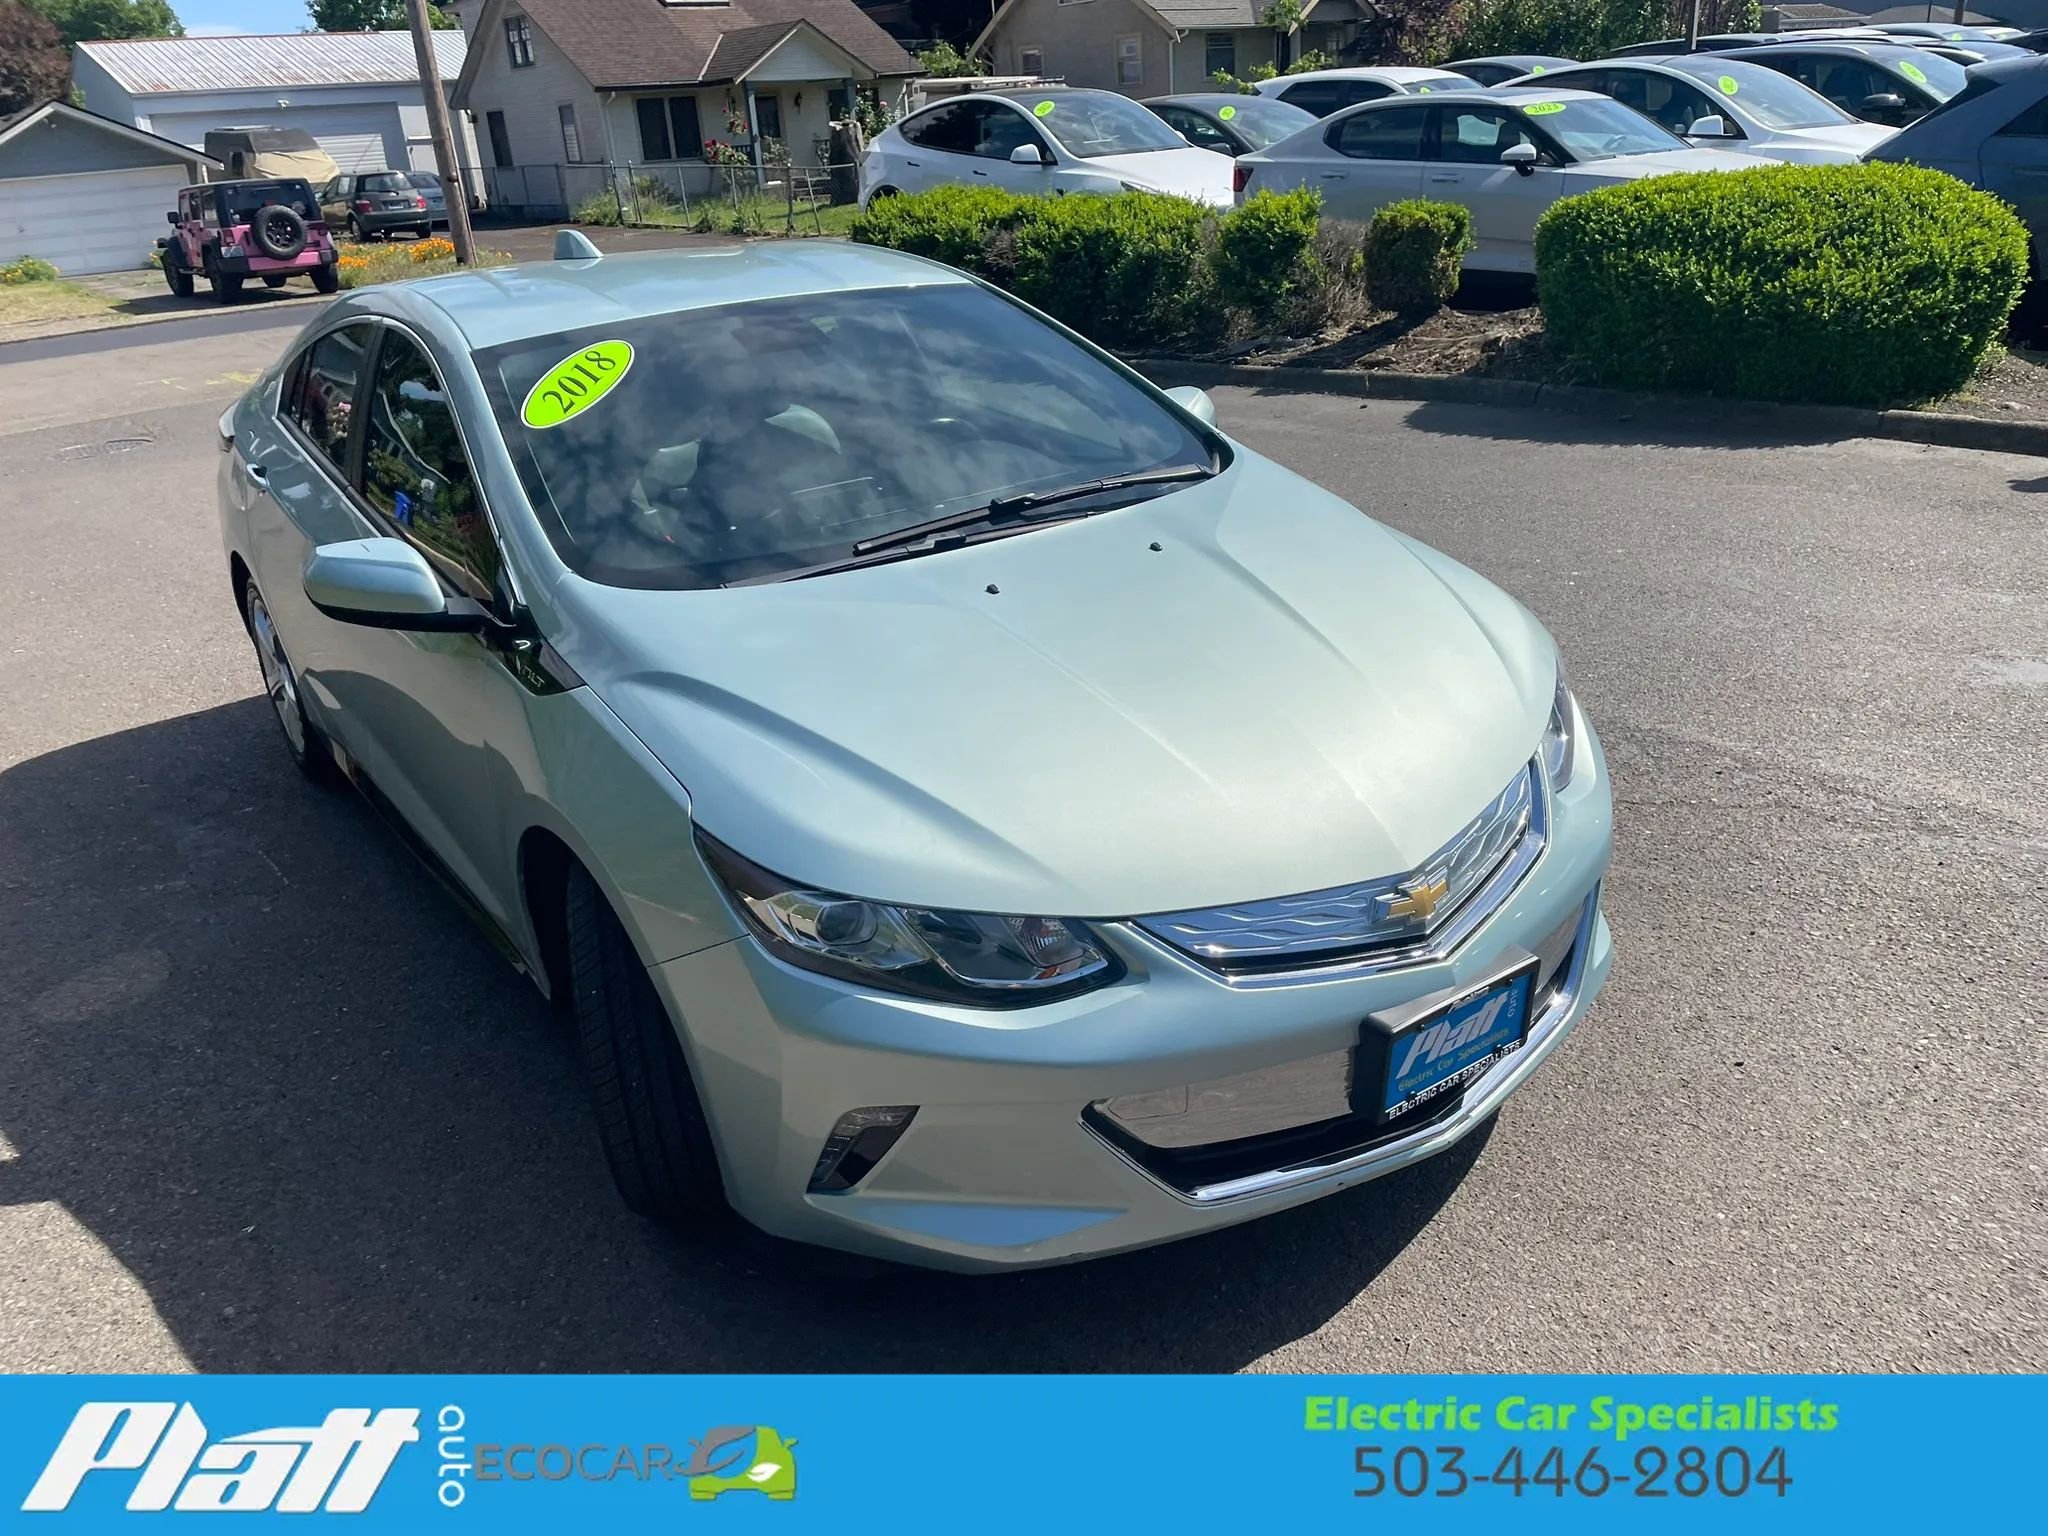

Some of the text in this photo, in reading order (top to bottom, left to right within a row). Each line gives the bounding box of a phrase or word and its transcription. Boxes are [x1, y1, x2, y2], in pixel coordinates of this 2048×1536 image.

[542, 350, 616, 414] 2018
[1396, 990, 1509, 1080] Platt
[1389, 1041, 1520, 1120] ELECTRIC CAR SPECIALISTS
